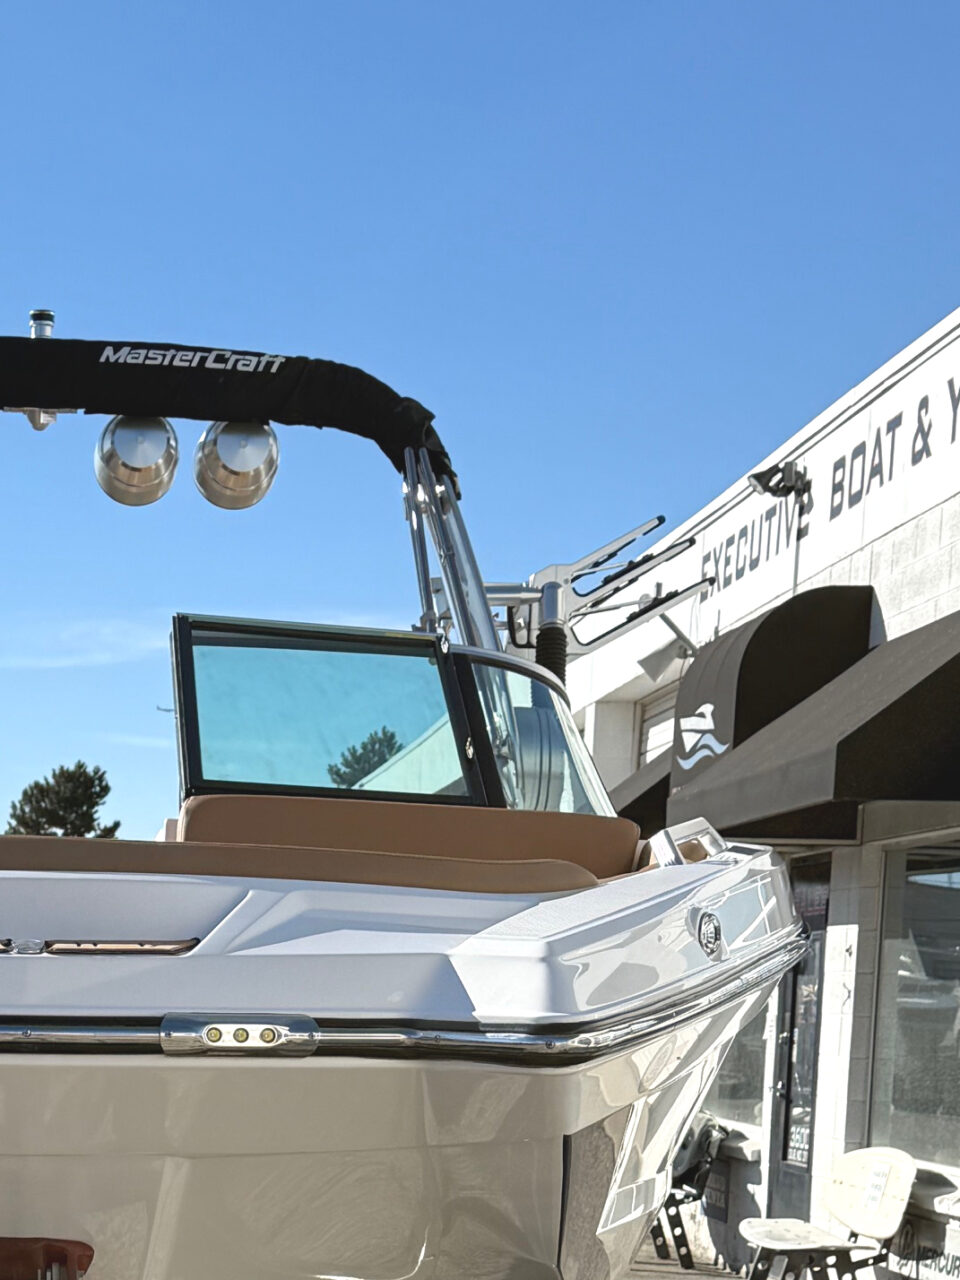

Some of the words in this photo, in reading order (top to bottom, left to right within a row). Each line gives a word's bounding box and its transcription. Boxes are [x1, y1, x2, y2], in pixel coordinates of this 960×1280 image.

[99, 345, 286, 374] MasterCraft
[829, 411, 904, 522] BOAT
[911, 394, 933, 467] &
